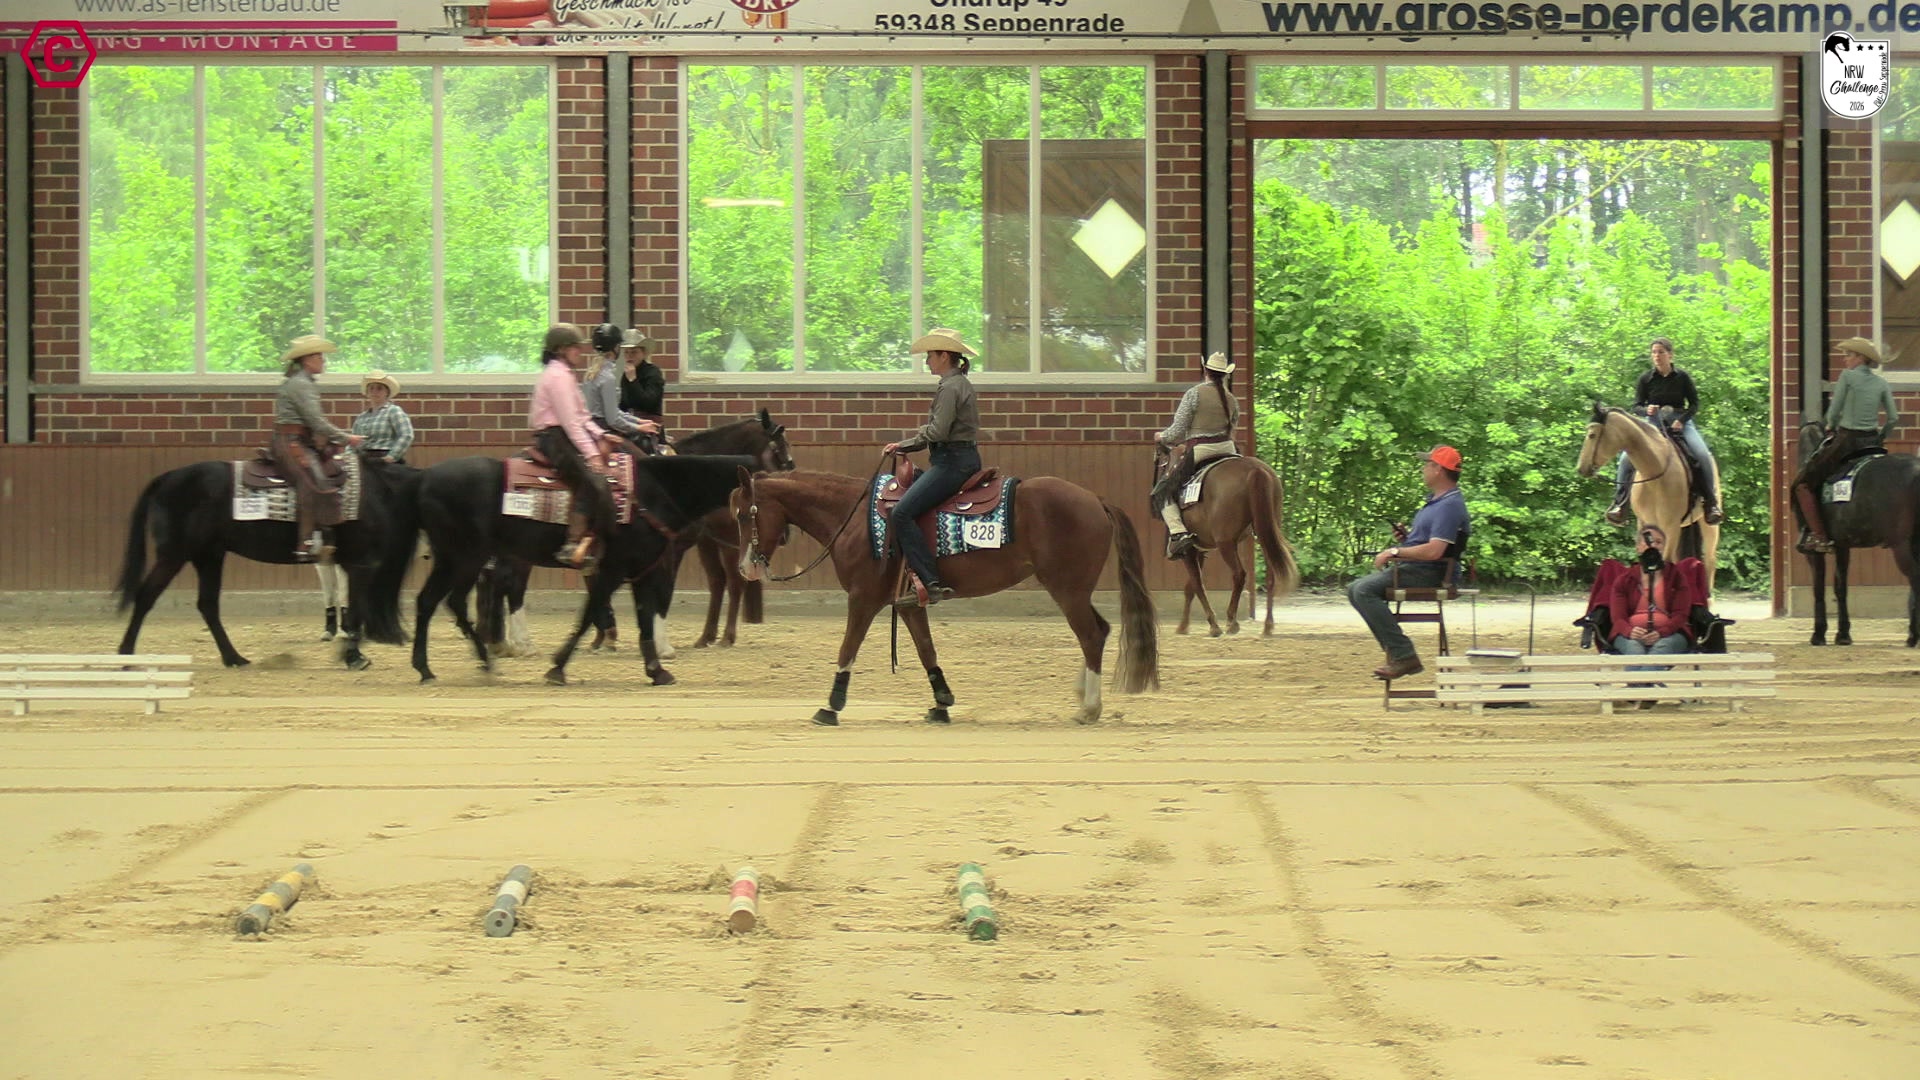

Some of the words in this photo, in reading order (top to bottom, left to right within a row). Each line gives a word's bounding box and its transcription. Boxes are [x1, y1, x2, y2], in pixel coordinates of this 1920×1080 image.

[874, 14, 955, 31] 59348
[963, 13, 1125, 32] Seppenrade
[970, 524, 995, 540] 828
